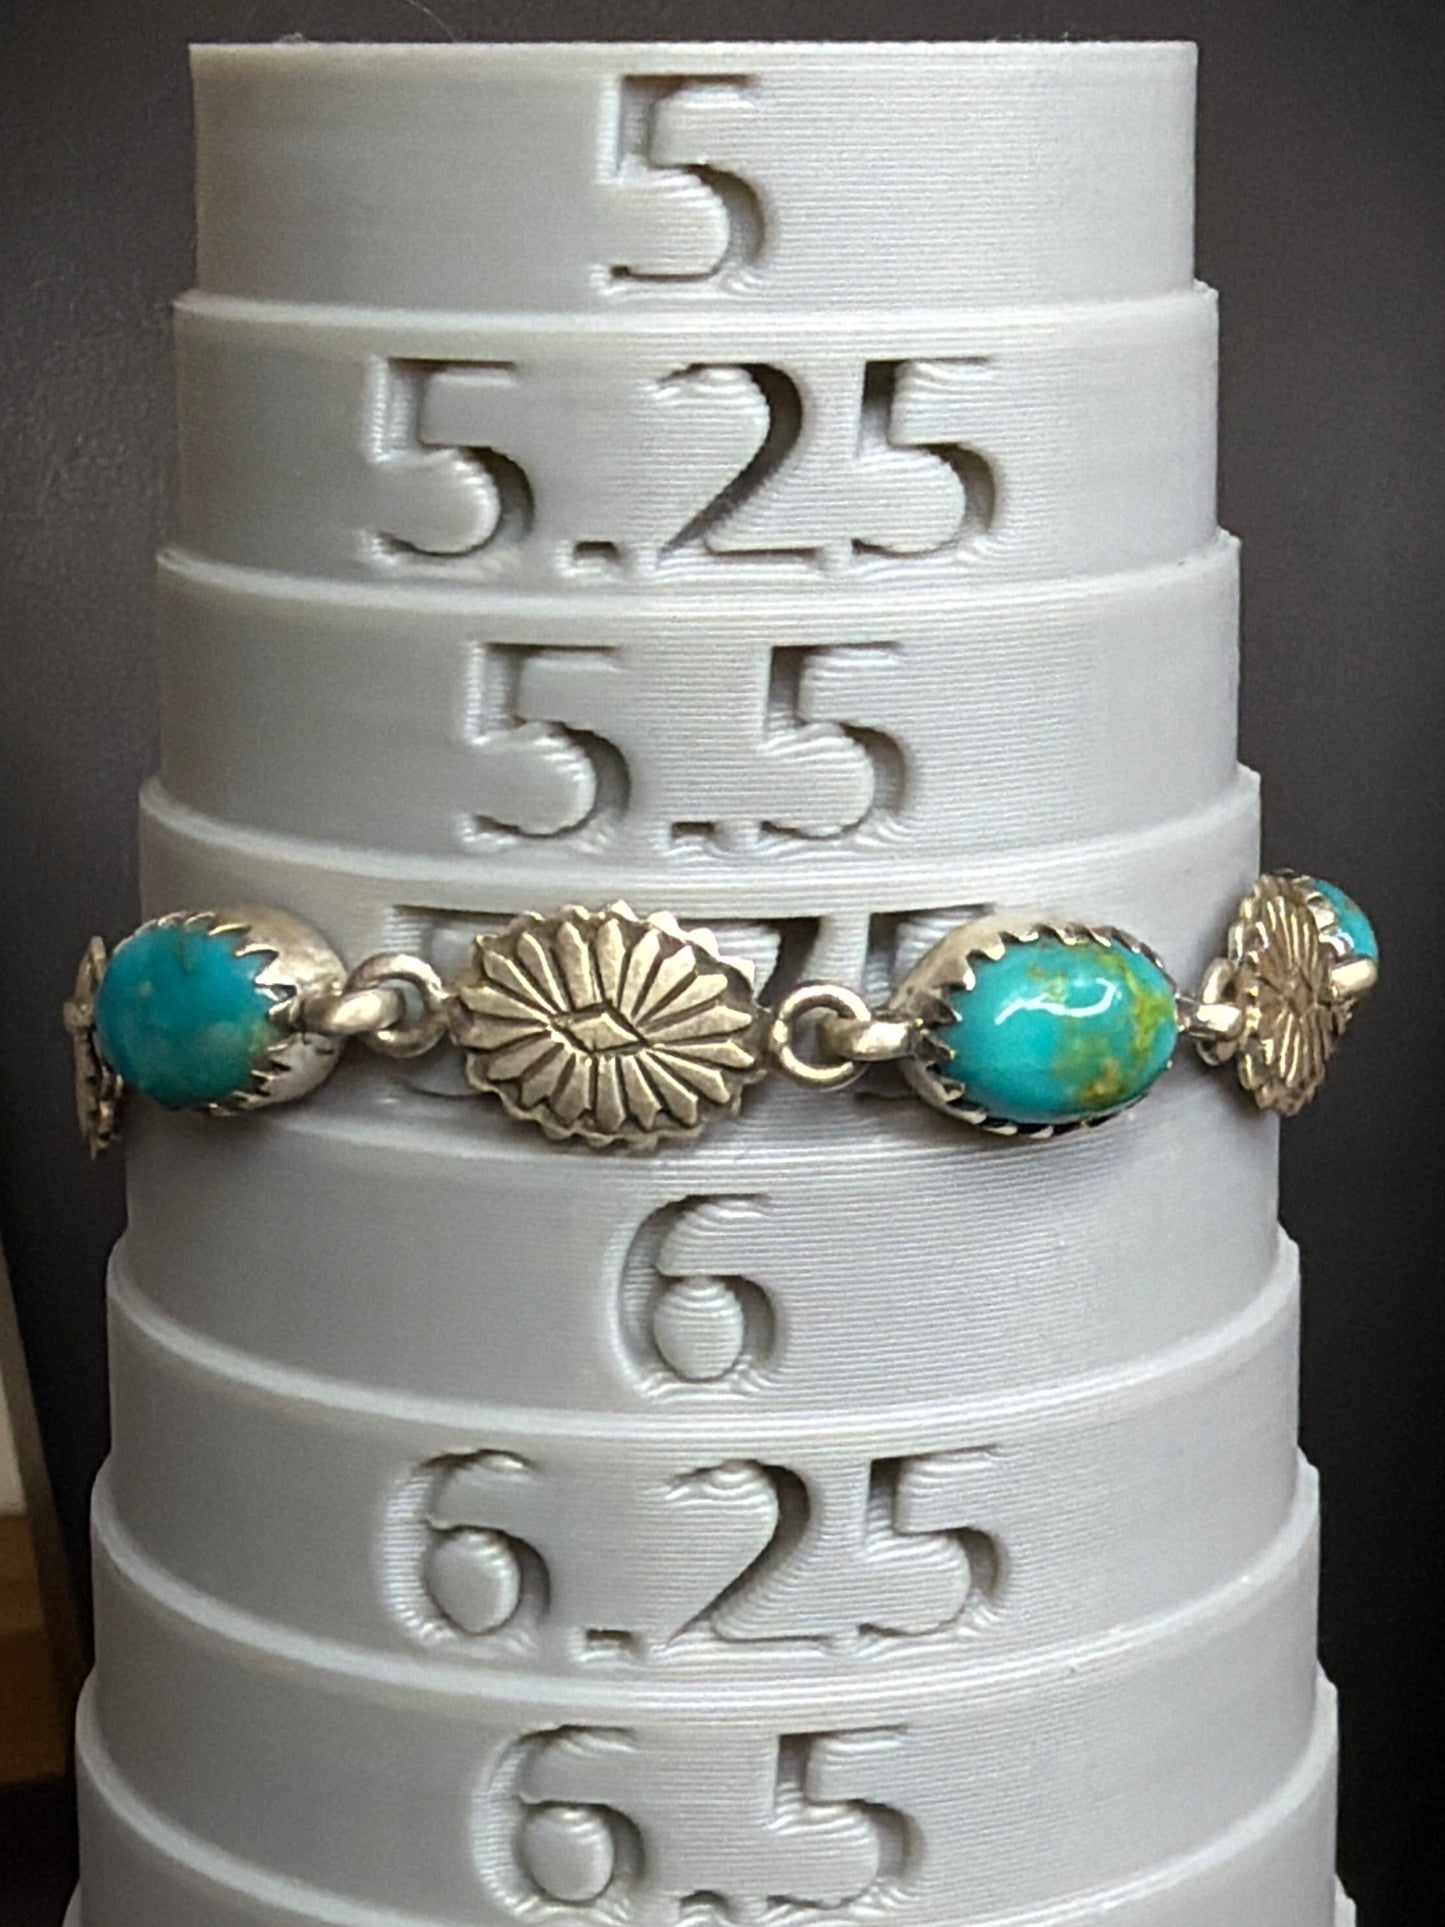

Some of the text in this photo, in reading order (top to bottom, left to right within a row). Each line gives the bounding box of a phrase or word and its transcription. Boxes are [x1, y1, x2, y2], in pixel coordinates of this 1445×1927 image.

[592, 73, 772, 294] 5
[359, 356, 1003, 576] 5.25
[458, 640, 915, 852] 5.5
[605, 1192, 785, 1399] 6
[382, 1445, 1008, 1664] 6.25
[473, 1723, 924, 1926] 6.5
